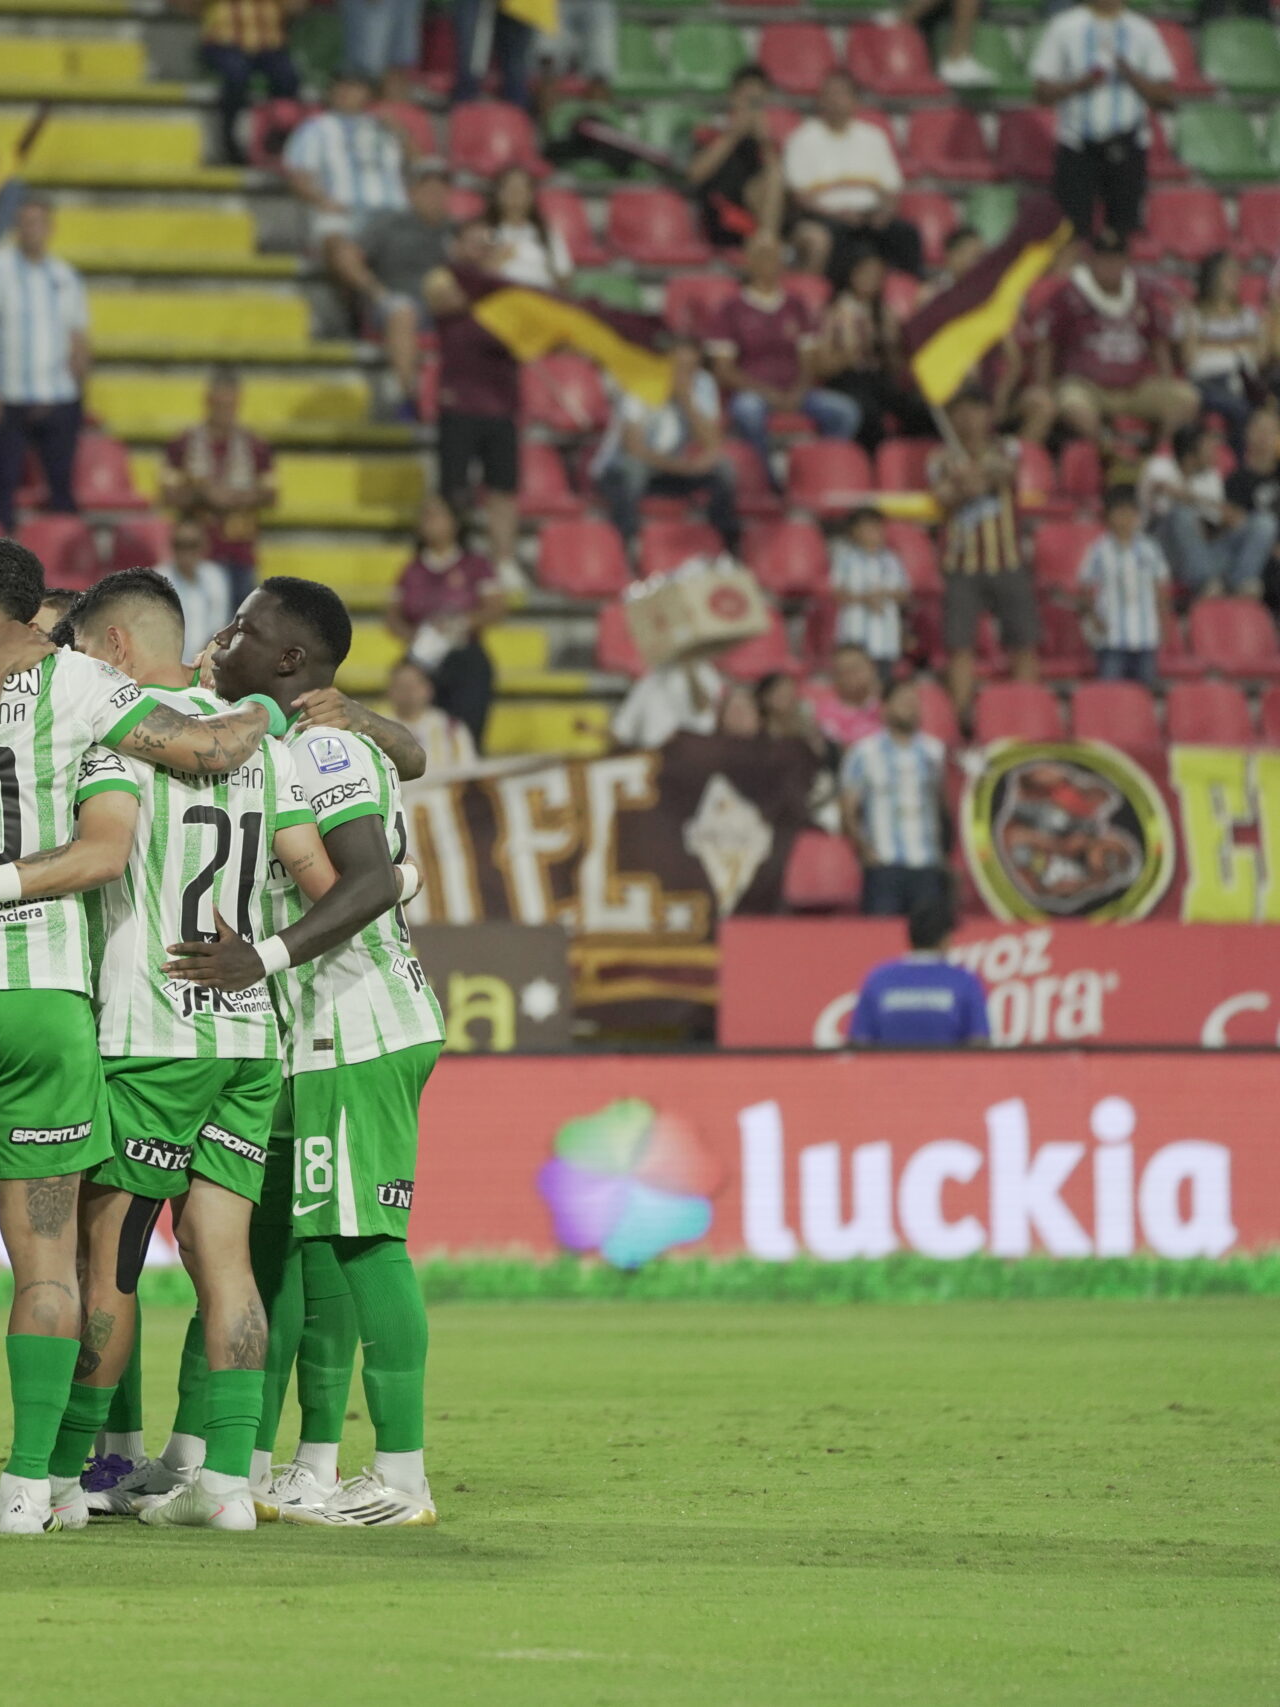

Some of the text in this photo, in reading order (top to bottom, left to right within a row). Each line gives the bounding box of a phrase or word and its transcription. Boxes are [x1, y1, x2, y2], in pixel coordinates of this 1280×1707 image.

[311, 785, 345, 815] TVS
[180, 805, 263, 944] 21
[182, 986, 236, 1018] JFK
[125, 1138, 191, 1170] ÚNIC
[201, 1124, 267, 1164] SPORTLI
[294, 1136, 334, 1194] 18
[737, 1096, 1239, 1261] luckia
